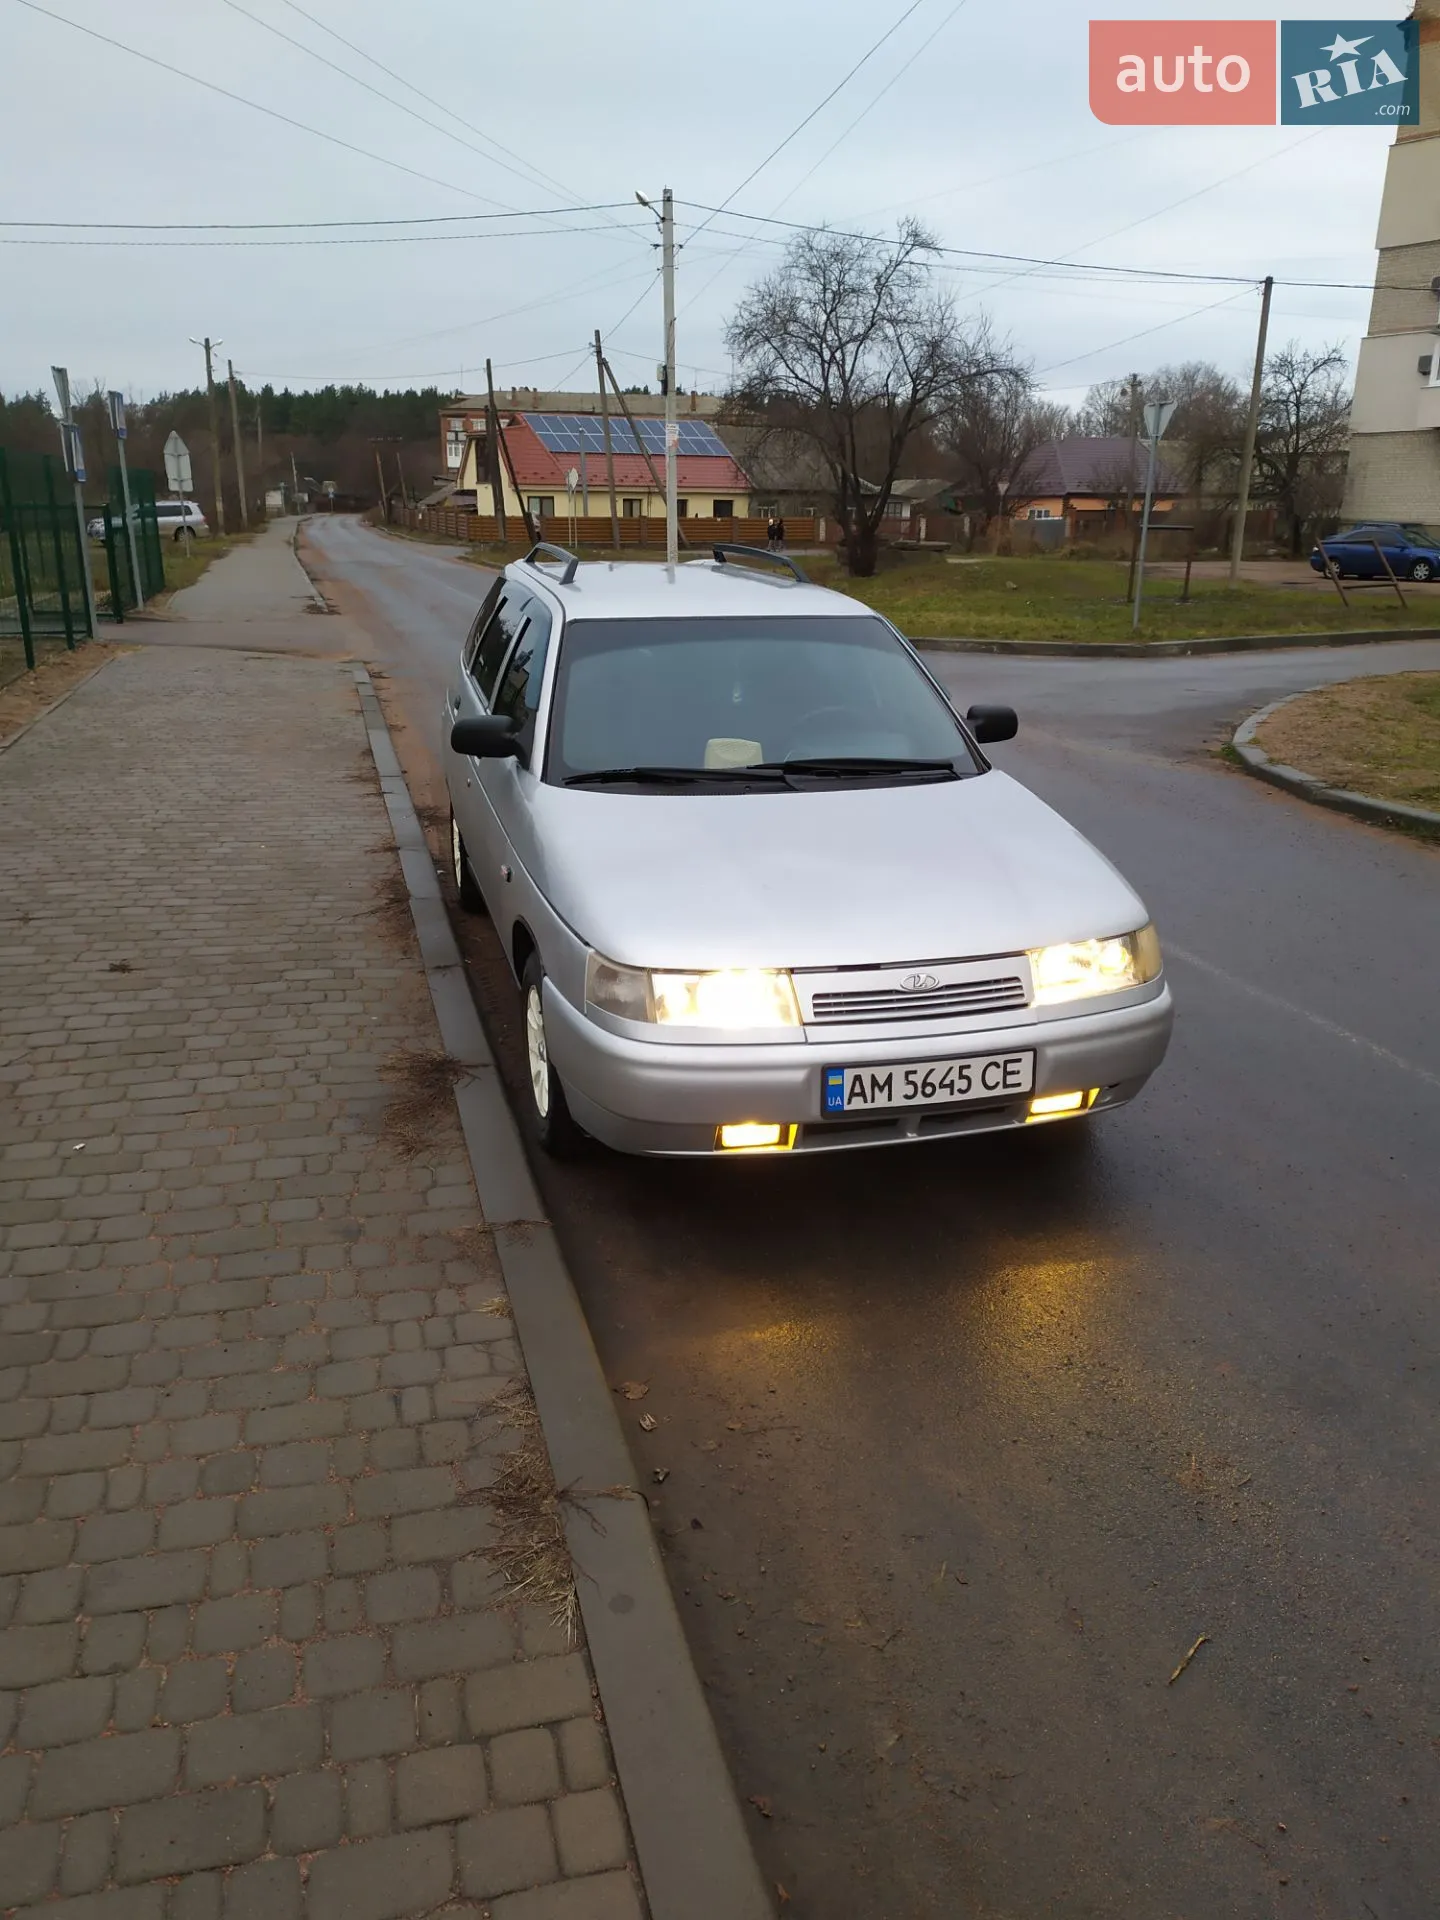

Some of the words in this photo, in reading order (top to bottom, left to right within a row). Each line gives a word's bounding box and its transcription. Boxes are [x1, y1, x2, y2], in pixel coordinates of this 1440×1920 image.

[846, 1071, 893, 1106] AM
[902, 1064, 973, 1101] 5645
[980, 1057, 1023, 1092] CE
[828, 1095, 843, 1107] UA
